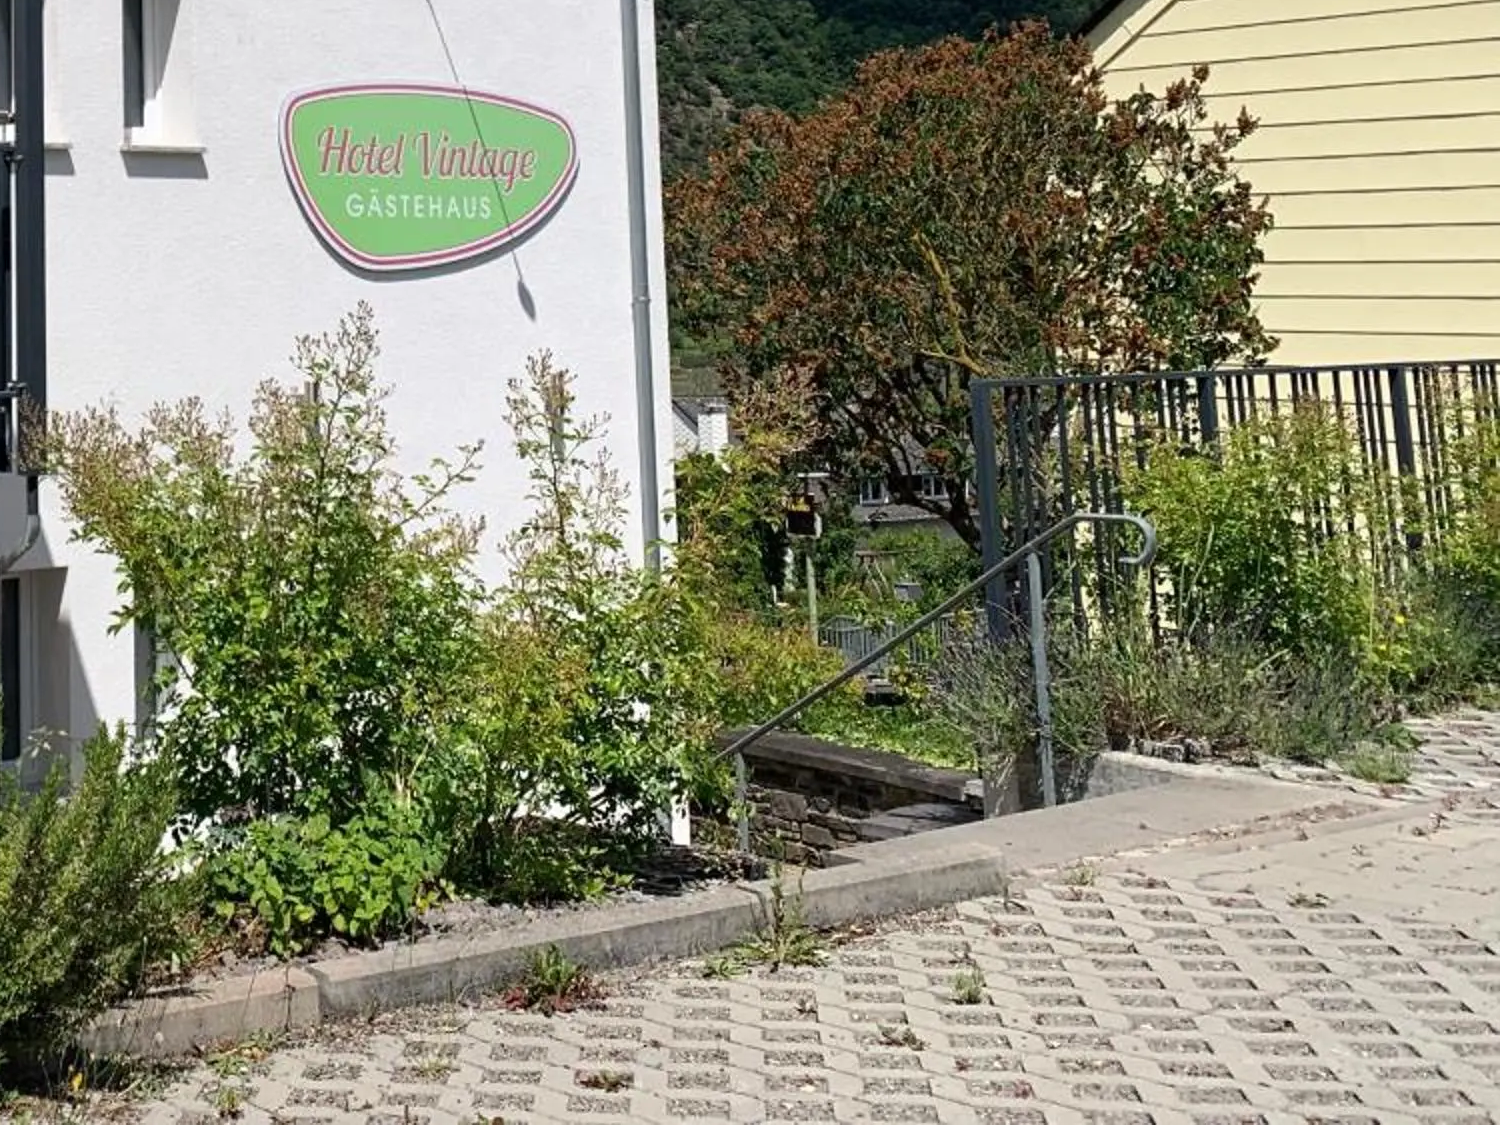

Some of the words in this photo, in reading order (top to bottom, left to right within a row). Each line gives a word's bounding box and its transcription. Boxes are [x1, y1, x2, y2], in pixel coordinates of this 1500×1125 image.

[317, 126, 404, 177] Hotel
[412, 131, 537, 193] Vintage
[345, 189, 492, 220] GÄSTEHAUS
